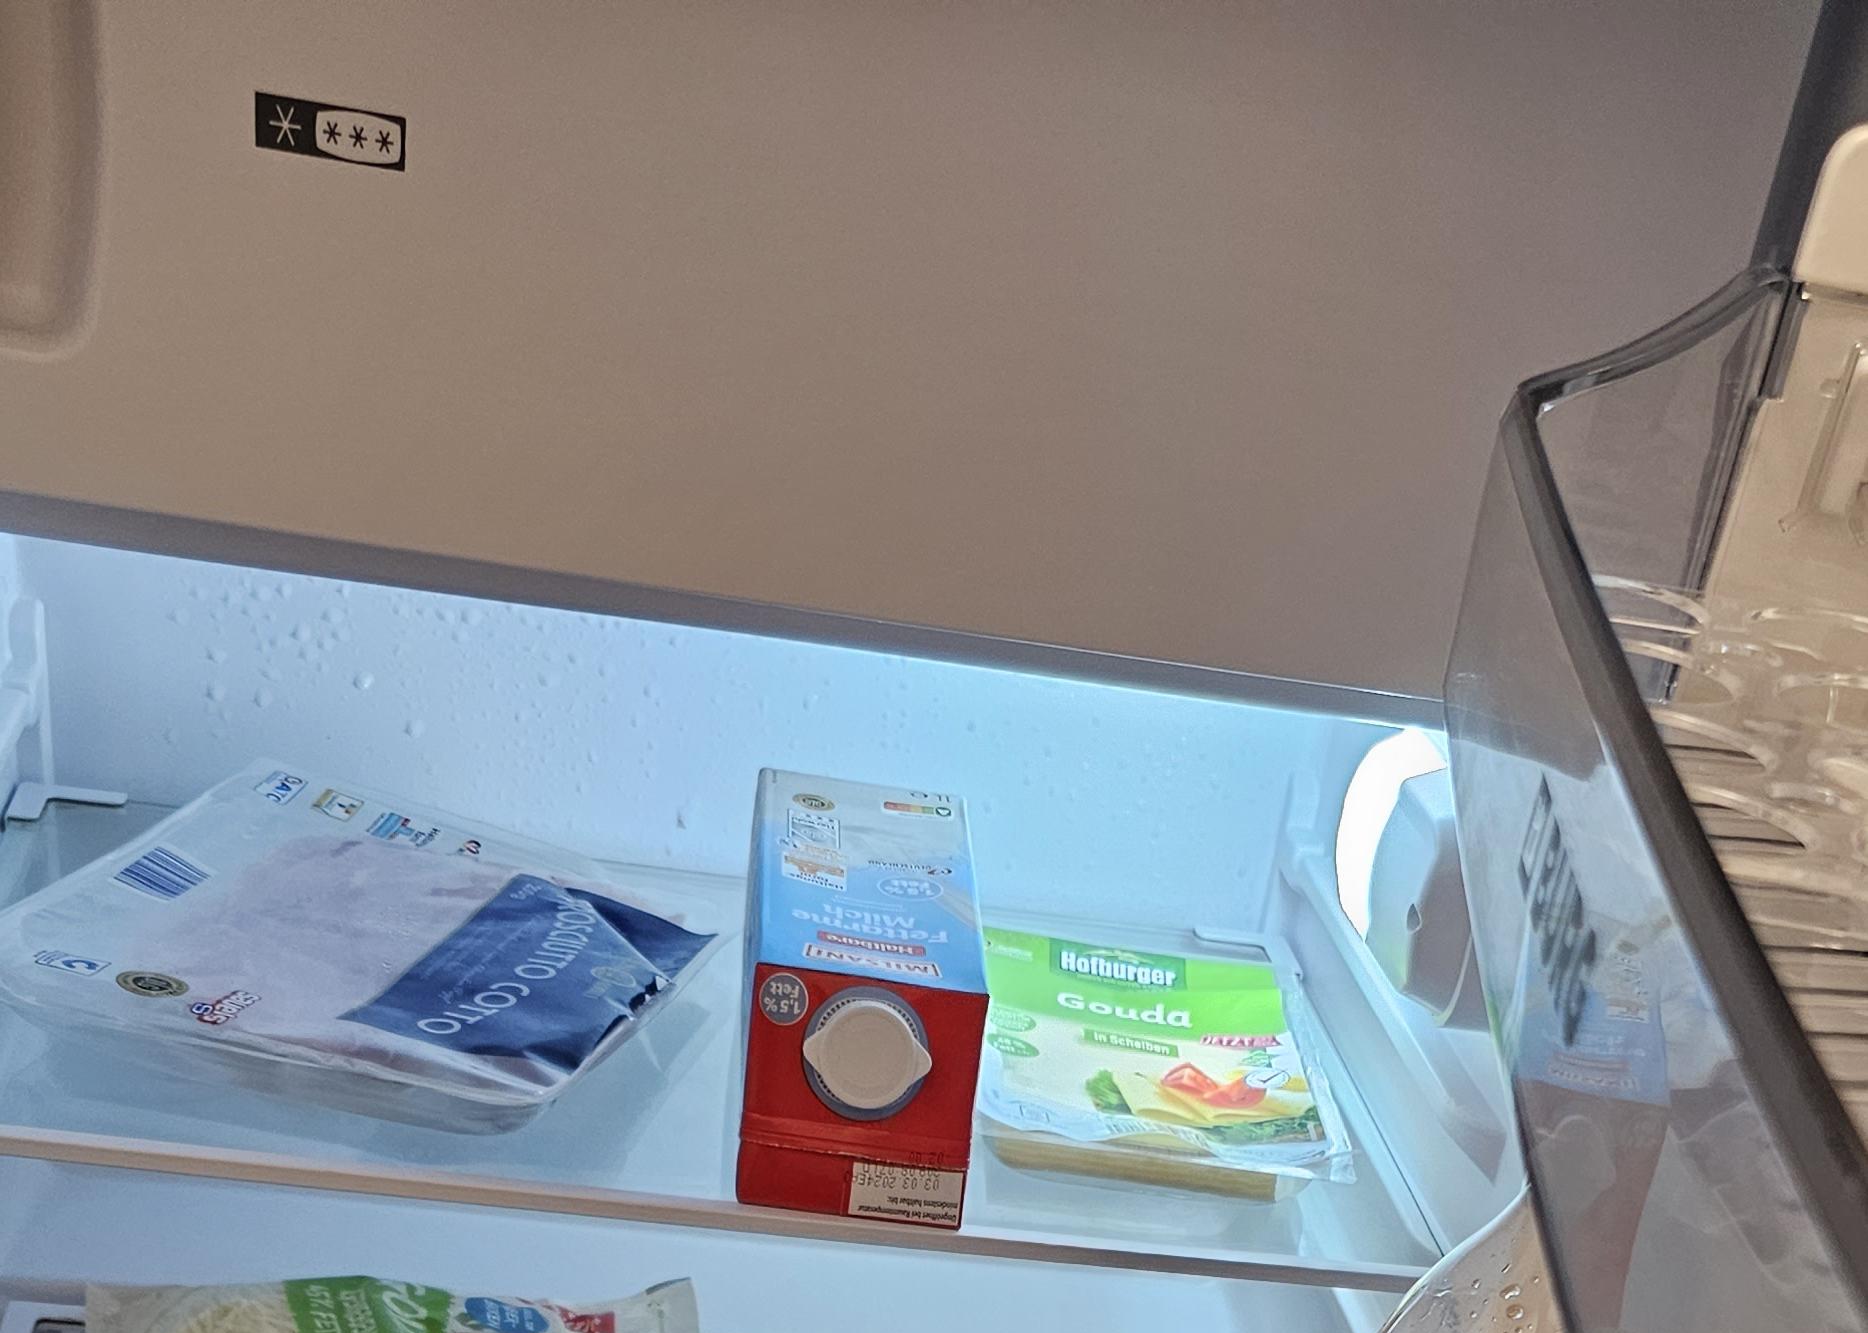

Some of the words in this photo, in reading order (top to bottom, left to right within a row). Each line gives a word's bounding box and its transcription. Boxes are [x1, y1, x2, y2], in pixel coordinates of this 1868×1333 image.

[792, 908, 949, 944] Fettarme
[824, 903, 915, 928] Milch
[1060, 950, 1177, 987] Hofburger
[769, 981, 800, 998] Fett
[416, 982, 531, 1034] COTTO
[779, 999, 801, 1015] 1,5
[1057, 992, 1193, 1028] Gouda
[1110, 1033, 1170, 1056] Scheiben
